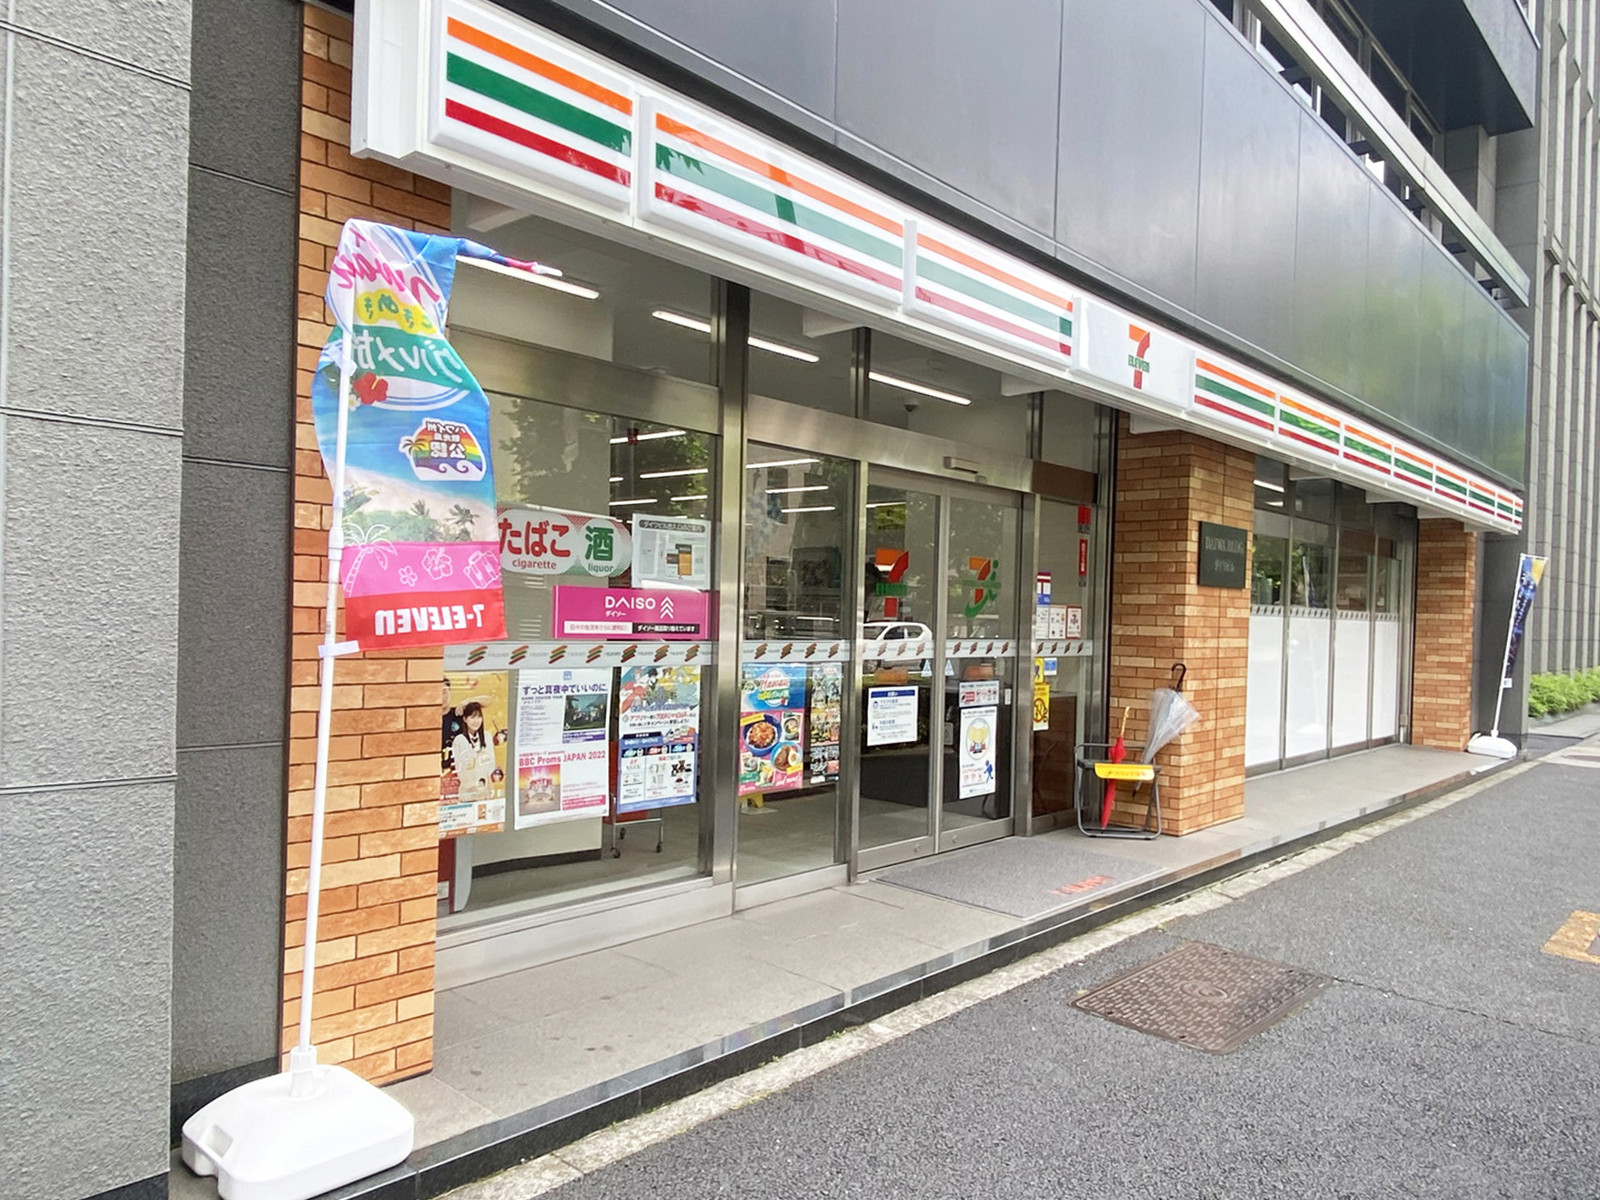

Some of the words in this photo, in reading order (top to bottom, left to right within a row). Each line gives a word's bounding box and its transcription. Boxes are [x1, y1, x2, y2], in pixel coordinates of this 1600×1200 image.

[1128, 323, 1151, 390] 7
[498, 517, 571, 558] たばこ
[585, 525, 614, 562] 酒
[512, 558, 557, 570] cigarette
[588, 562, 614, 574] liquor
[875, 548, 909, 618] 7
[605, 596, 656, 610] DAISO
[605, 610, 627, 618] ダイソー
[519, 757, 535, 767] BBC
[537, 756, 561, 765] Proms
[563, 752, 587, 763] JAPAN
[588, 750, 606, 760] 2022
